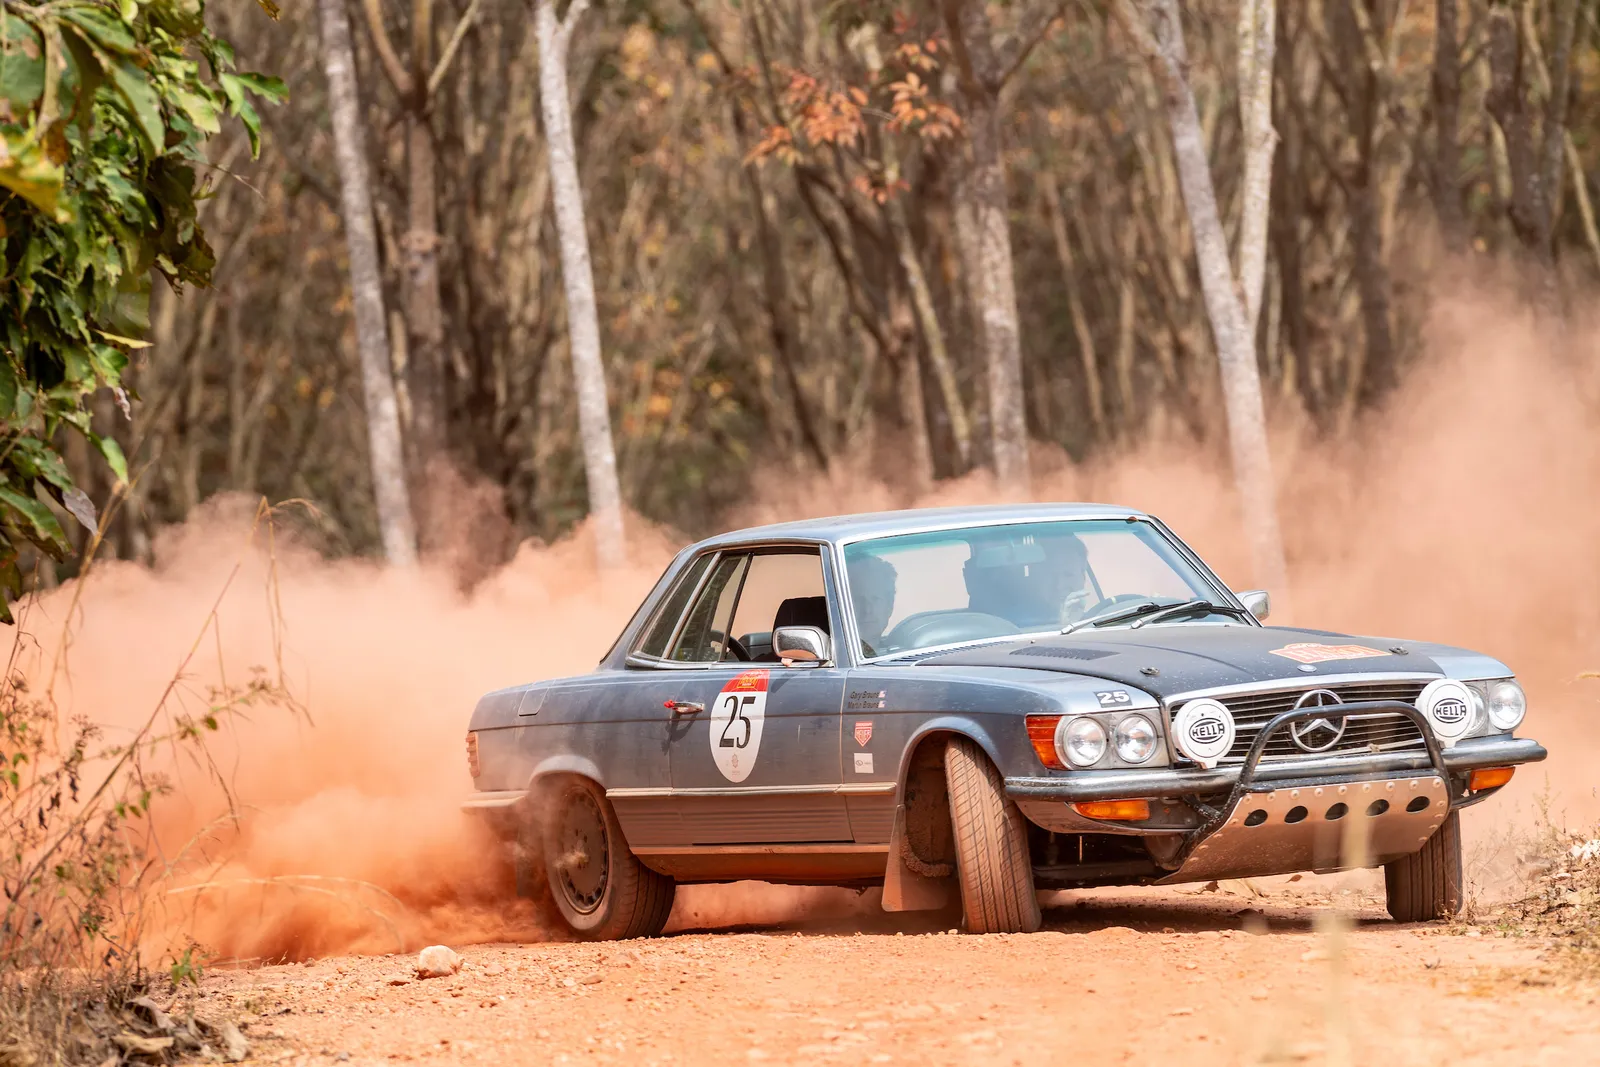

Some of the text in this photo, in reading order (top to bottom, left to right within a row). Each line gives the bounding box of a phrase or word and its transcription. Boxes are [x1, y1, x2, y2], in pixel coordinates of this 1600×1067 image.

[1096, 691, 1130, 704] 25
[1435, 704, 1467, 716] HELLA
[719, 695, 756, 749] 25
[1192, 722, 1225, 737] HELLA
